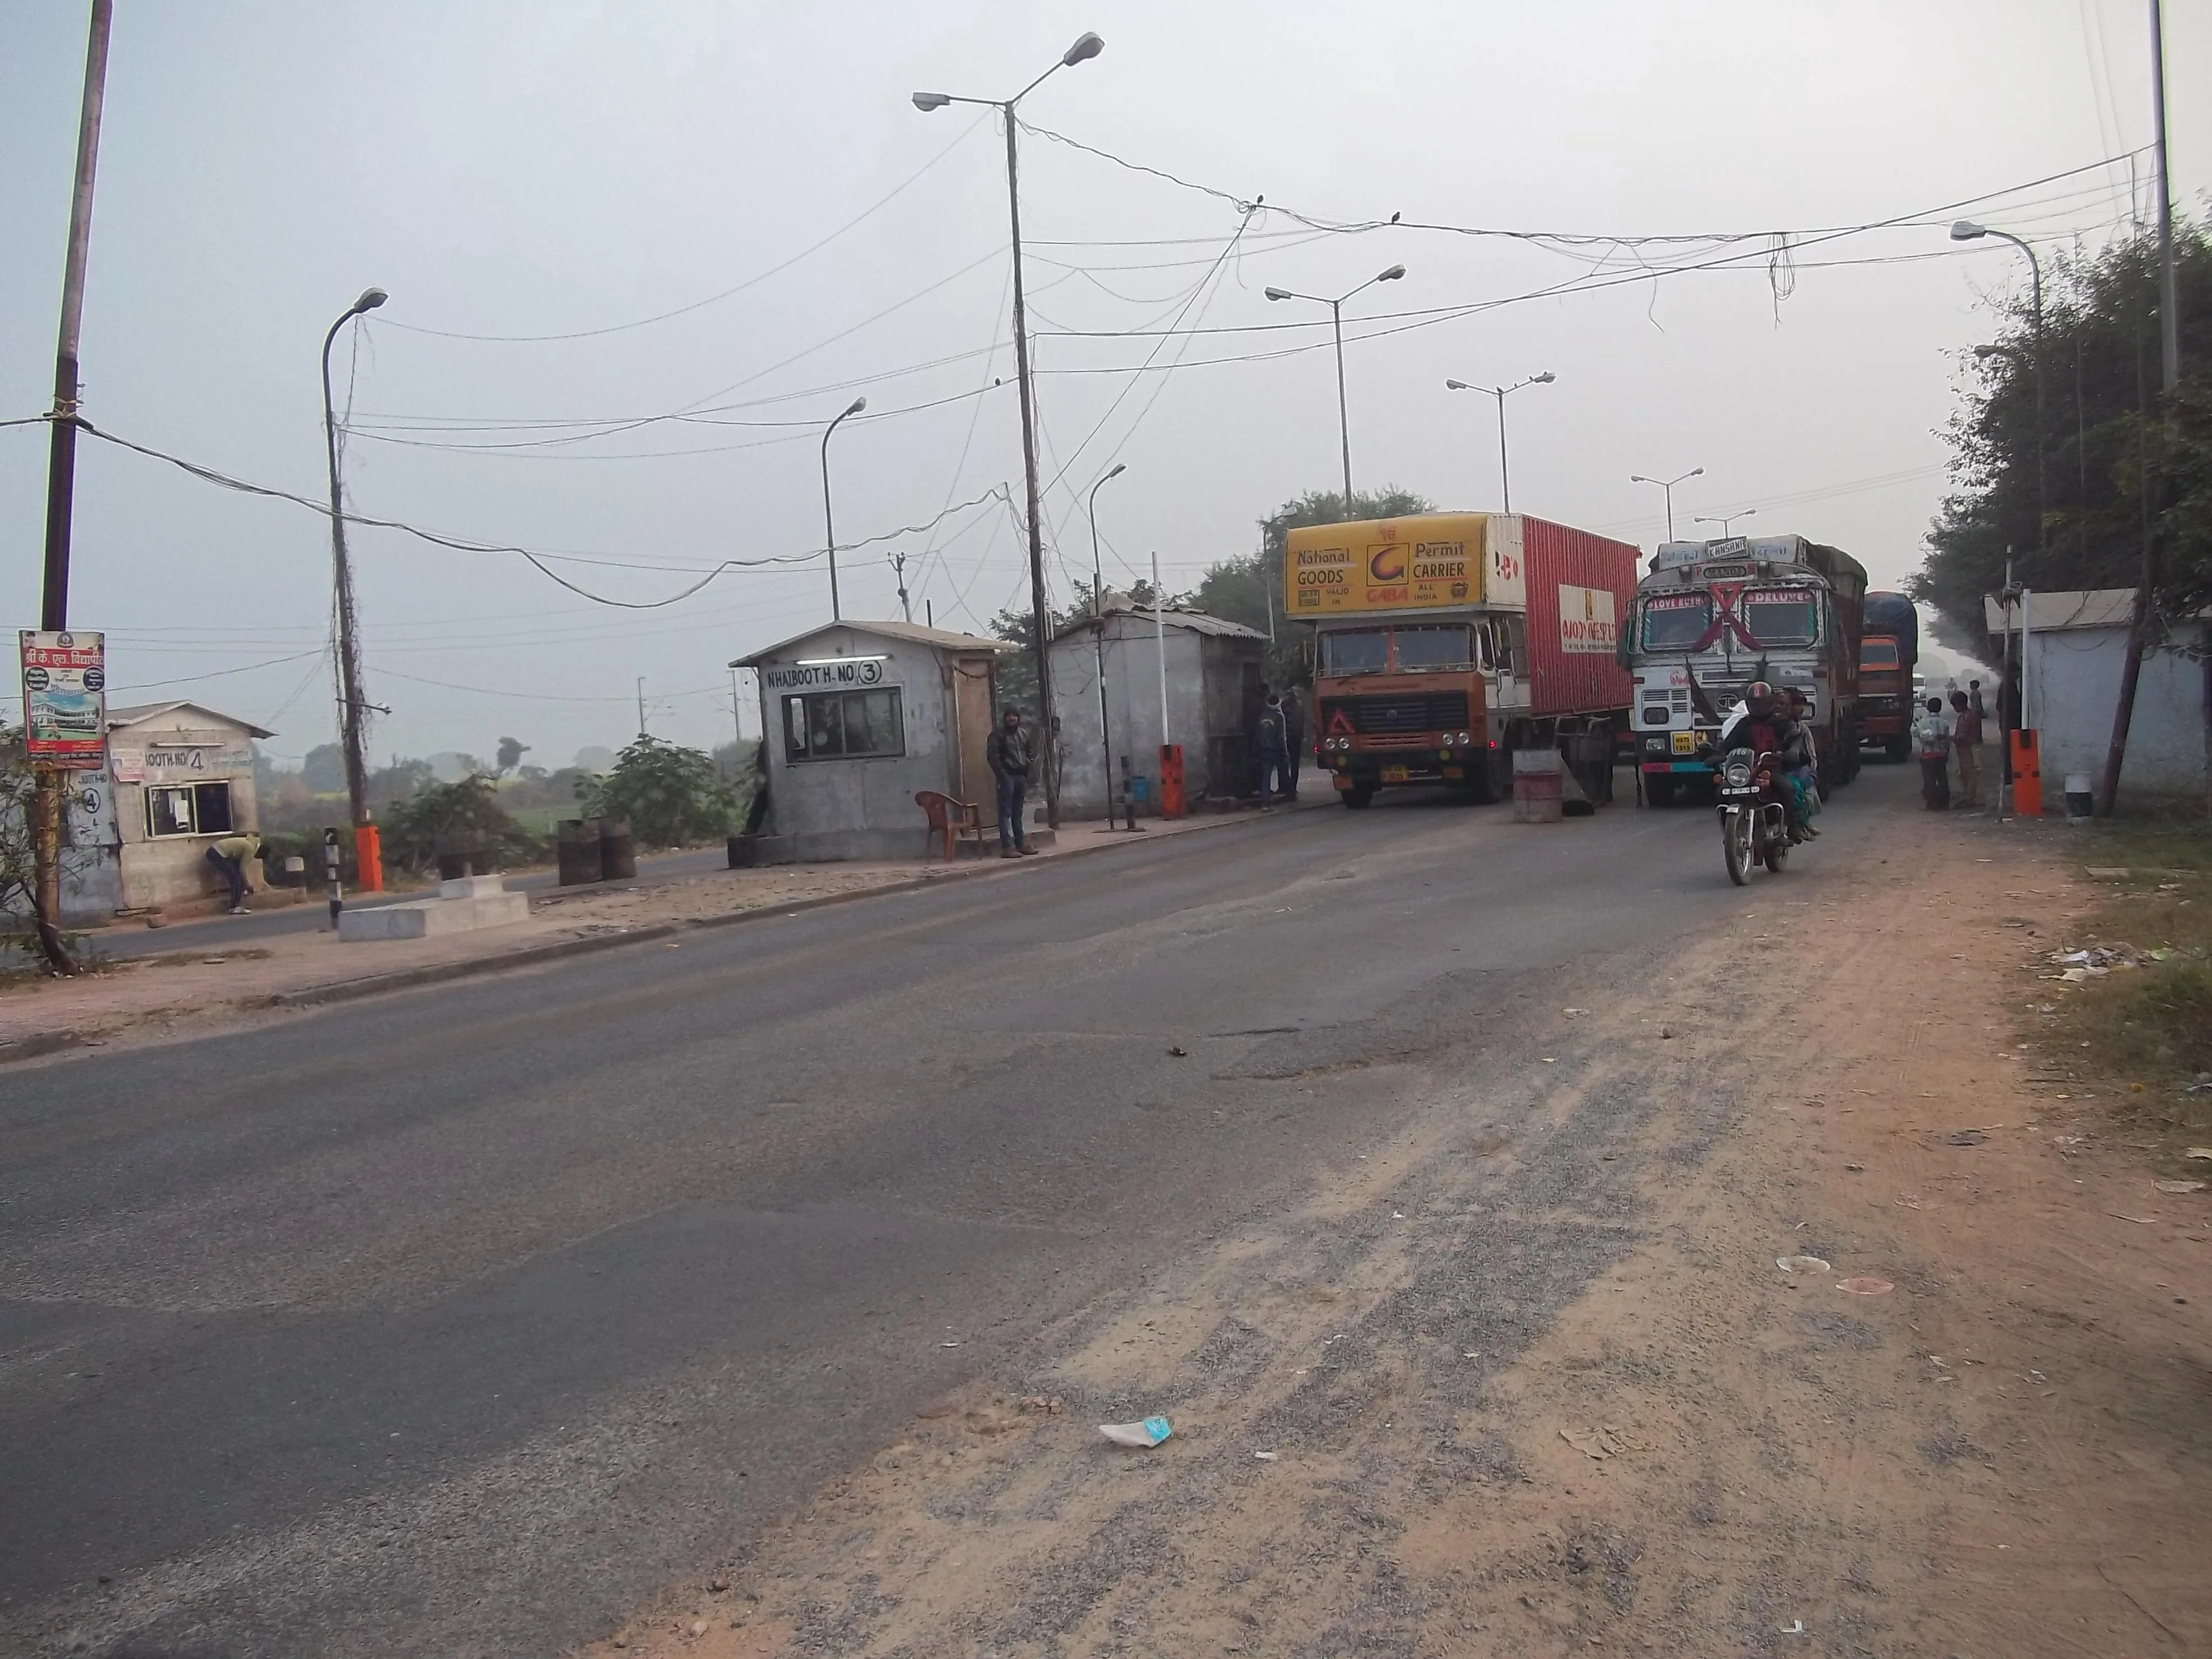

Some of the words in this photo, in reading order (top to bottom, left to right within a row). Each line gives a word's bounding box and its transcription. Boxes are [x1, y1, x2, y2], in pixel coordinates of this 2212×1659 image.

[1298, 547, 1350, 565] National
[1415, 541, 1465, 558] Permit
[1298, 569, 1345, 585] GOODS
[1413, 562, 1464, 578] CARRIER
[1366, 587, 1409, 603] GABA
[838, 664, 854, 682] NO
